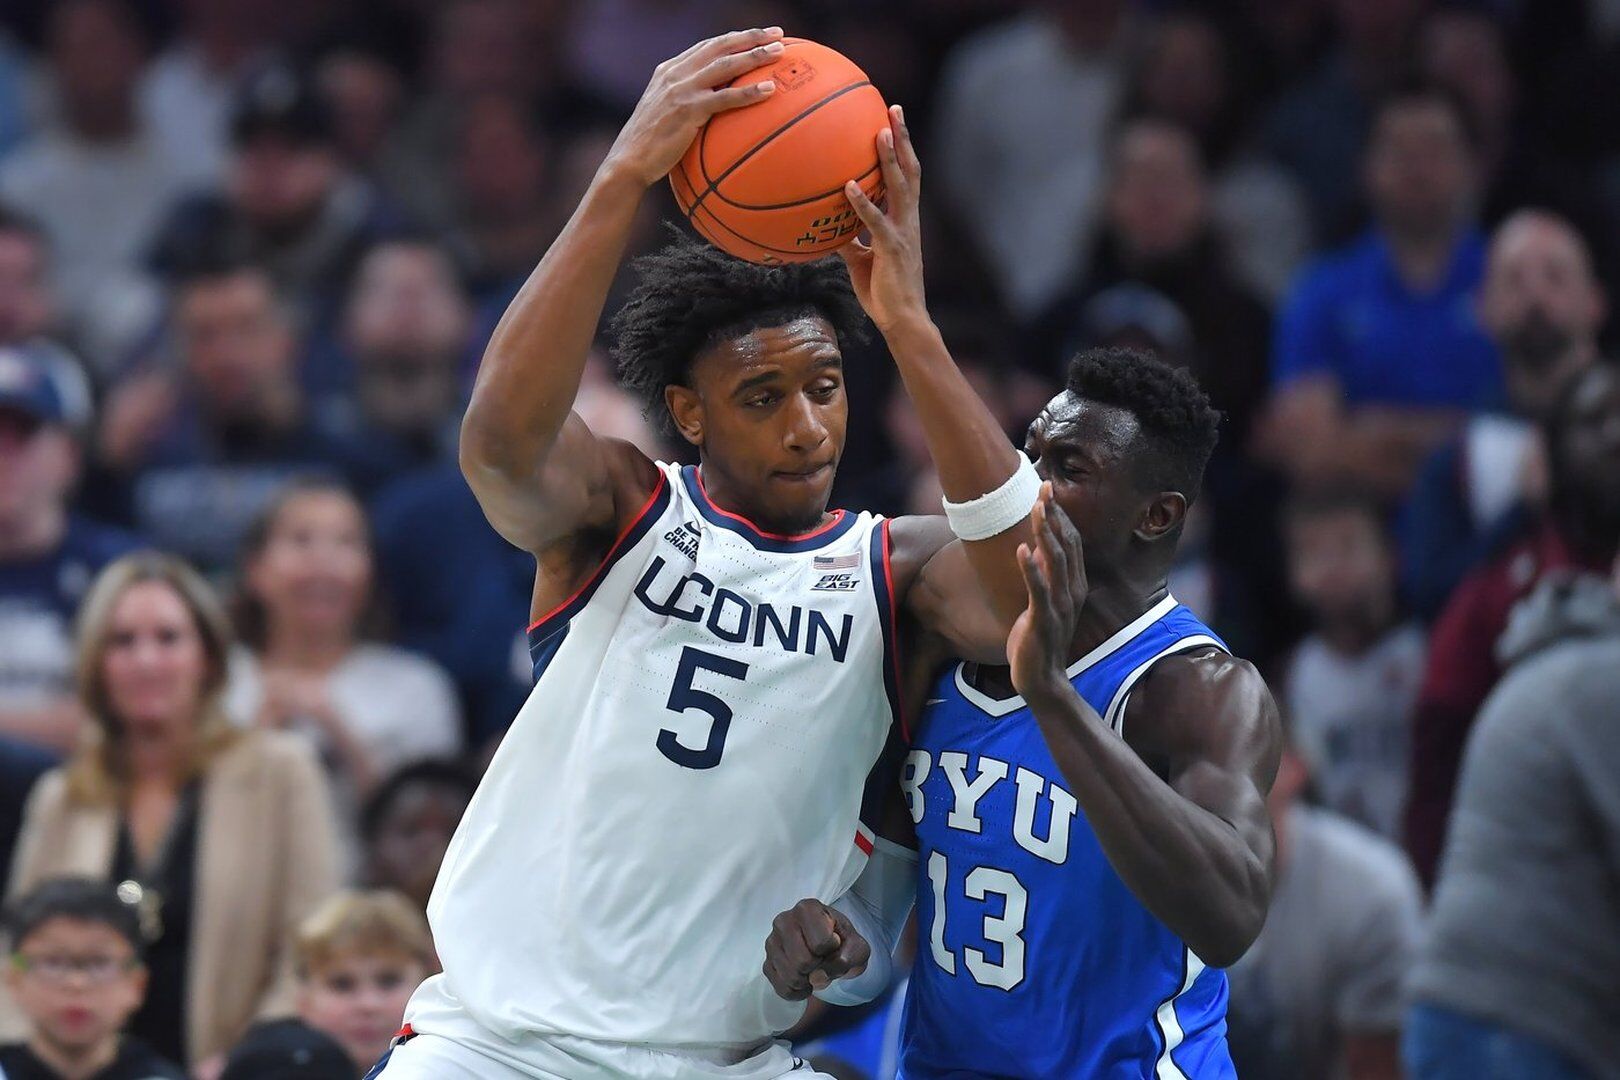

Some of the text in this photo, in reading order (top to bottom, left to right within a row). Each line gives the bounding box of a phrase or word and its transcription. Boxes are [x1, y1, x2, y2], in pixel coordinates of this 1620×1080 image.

[663, 531, 698, 563] CHANG
[674, 526, 700, 551] BE TH
[633, 554, 854, 664] UCONN
[813, 580, 861, 589] EAST
[819, 573, 853, 582] BIG
[655, 645, 750, 770] 5
[900, 749, 1078, 865] BYU
[927, 849, 1028, 992] 13
